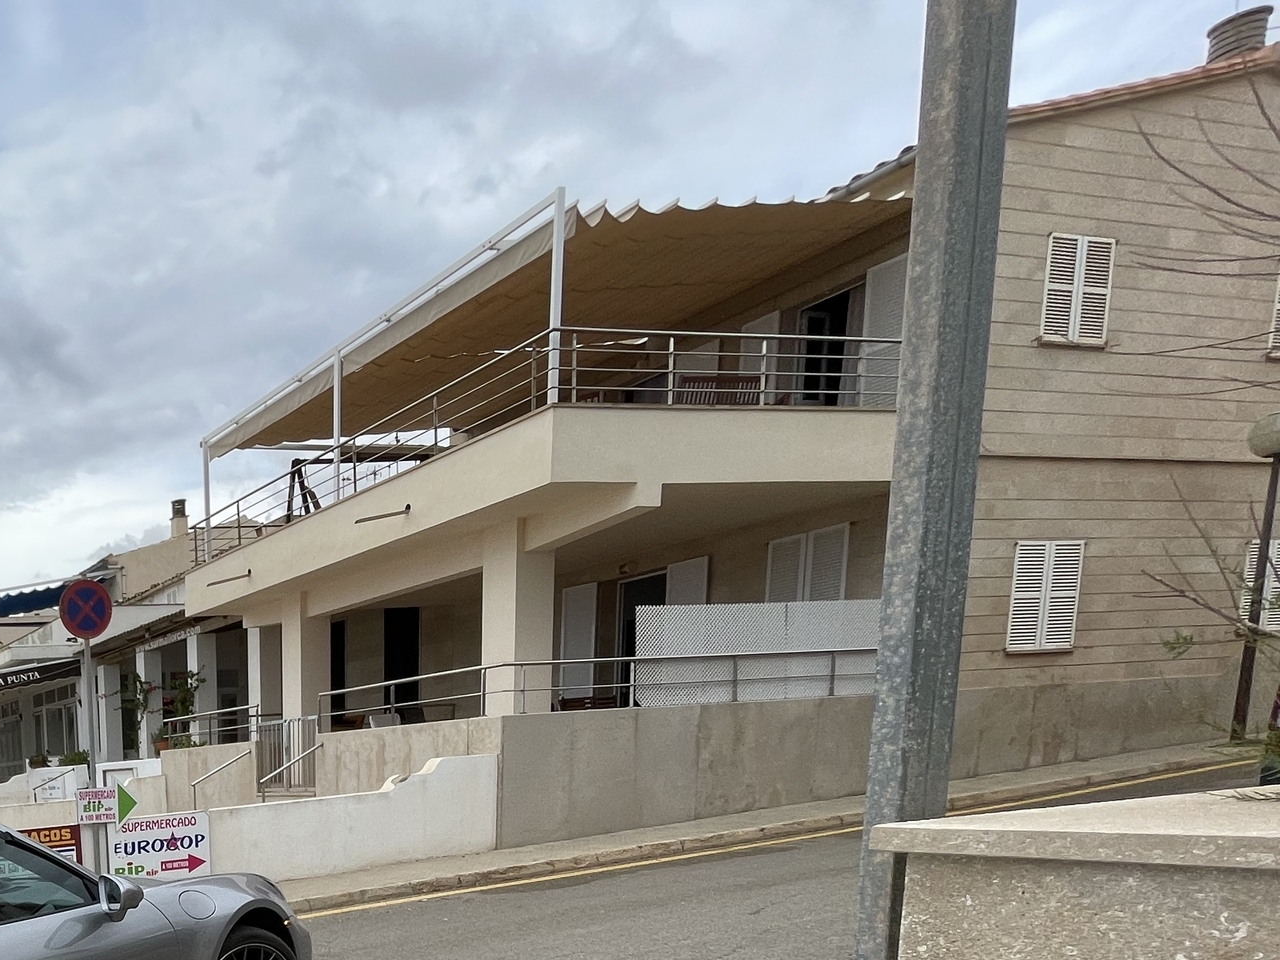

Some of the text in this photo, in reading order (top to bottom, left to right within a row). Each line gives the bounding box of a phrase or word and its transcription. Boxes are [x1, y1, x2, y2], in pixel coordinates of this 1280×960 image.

[7, 671, 41, 684] PUNTA
[78, 789, 116, 801] SUPERMERCADO
[85, 814, 94, 822] 100
[95, 813, 116, 821] METROS
[121, 816, 197, 833] SUPERMERCADO
[22, 828, 71, 843] ACOS
[114, 833, 206, 856] EUROCOP
